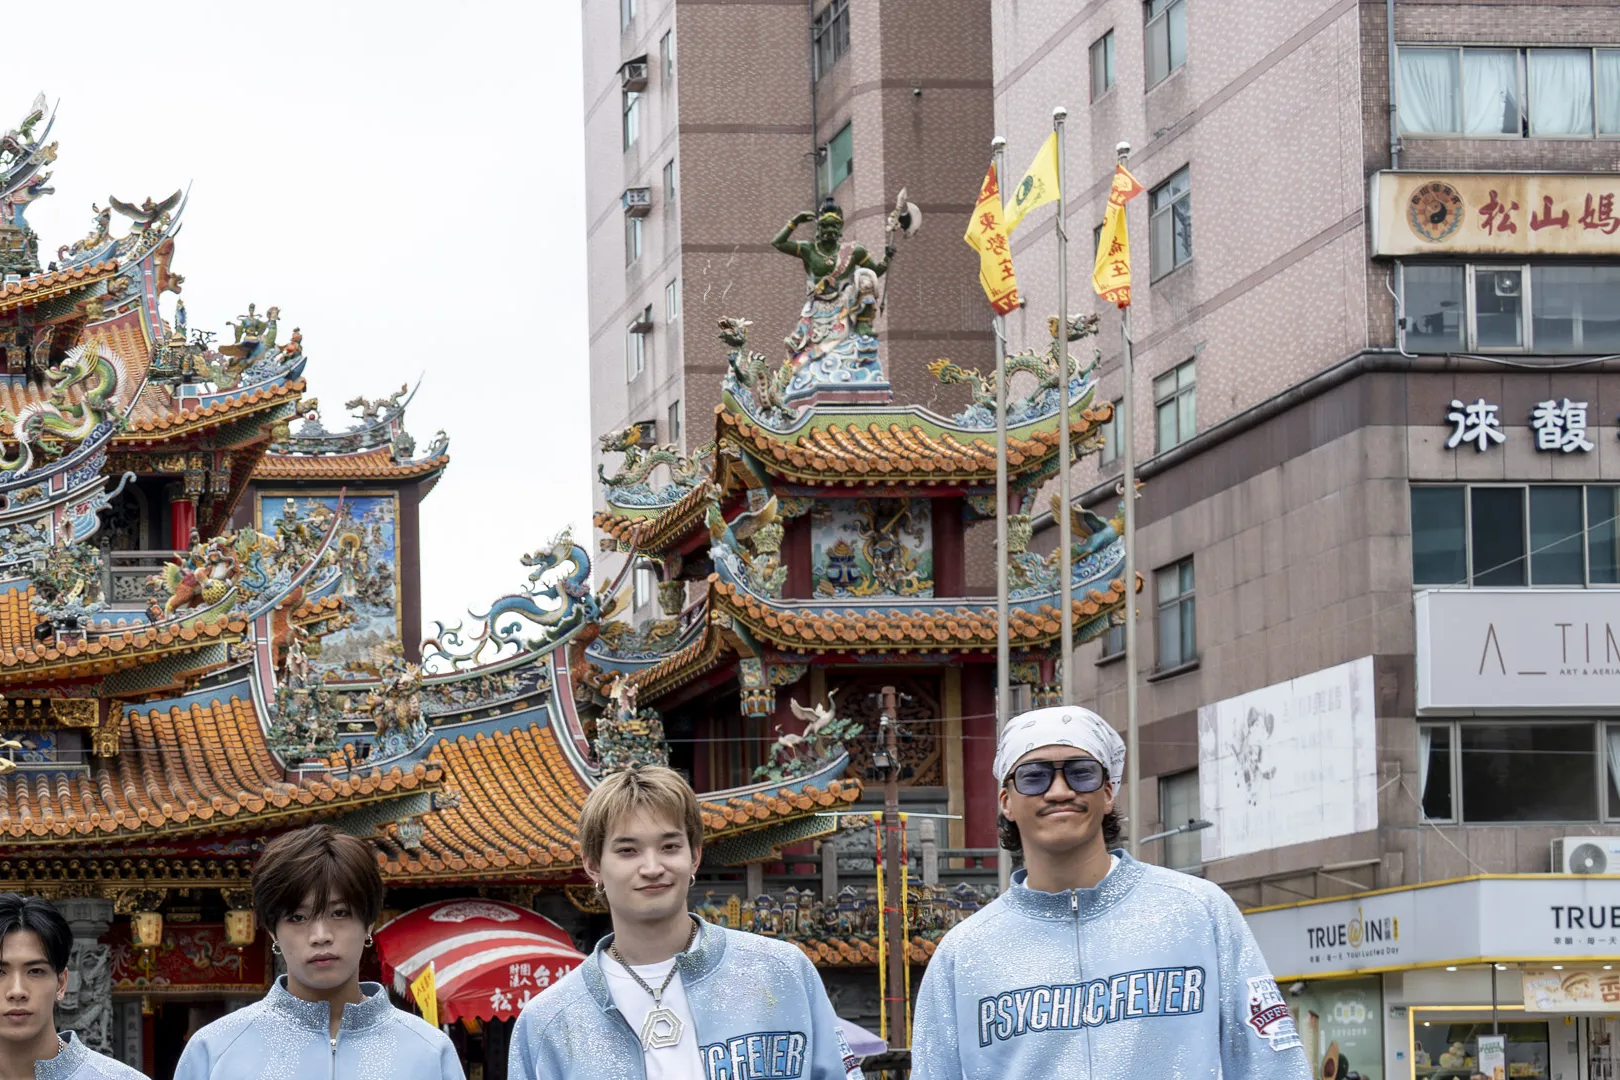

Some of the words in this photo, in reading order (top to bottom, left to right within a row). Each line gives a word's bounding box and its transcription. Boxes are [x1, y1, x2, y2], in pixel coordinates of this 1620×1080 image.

[1478, 189, 1620, 236] 松山媽
[1559, 668, 1578, 676] ART
